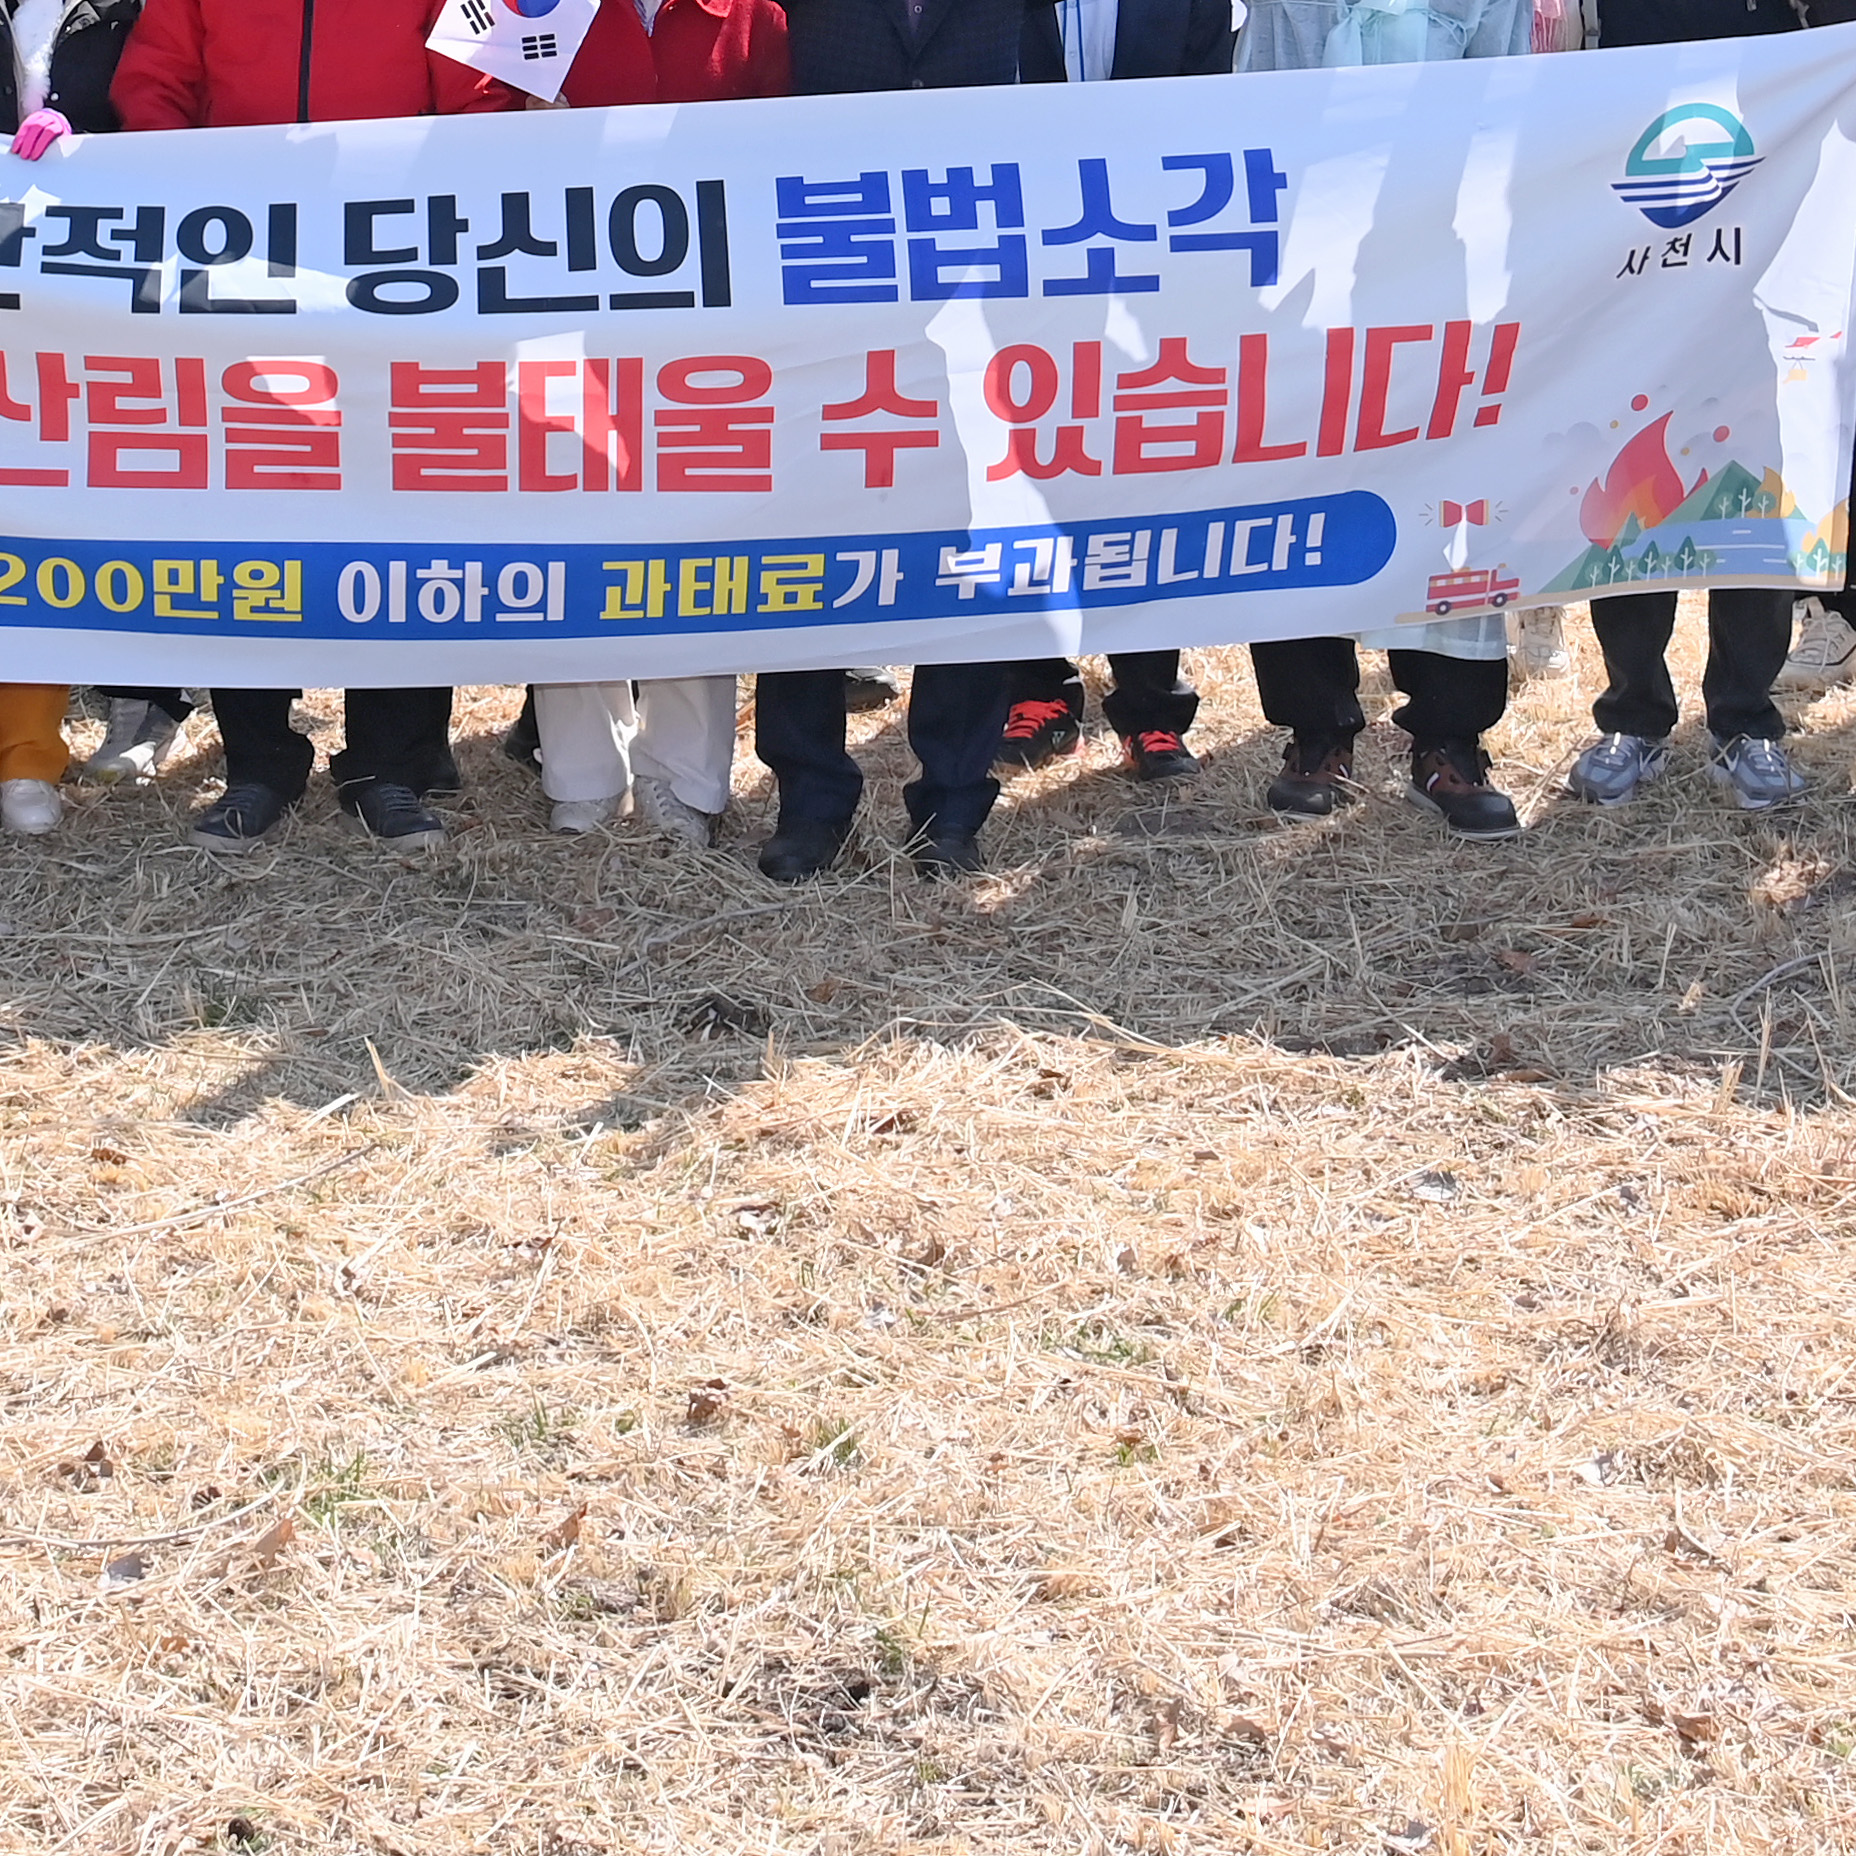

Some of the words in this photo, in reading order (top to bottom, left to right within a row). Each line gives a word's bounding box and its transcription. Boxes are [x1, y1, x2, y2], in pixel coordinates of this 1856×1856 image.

[343, 178, 732, 316] 당신의
[775, 147, 1289, 306] 불법소각
[1615, 226, 1742, 280] 사천시
[387, 354, 776, 493] 불태울
[819, 348, 940, 490] 수
[982, 318, 1522, 484] 있습니다!
[336, 558, 566, 624] 이하의
[598, 547, 905, 621] 과태료가
[934, 510, 1327, 601] 부과됩니다!
